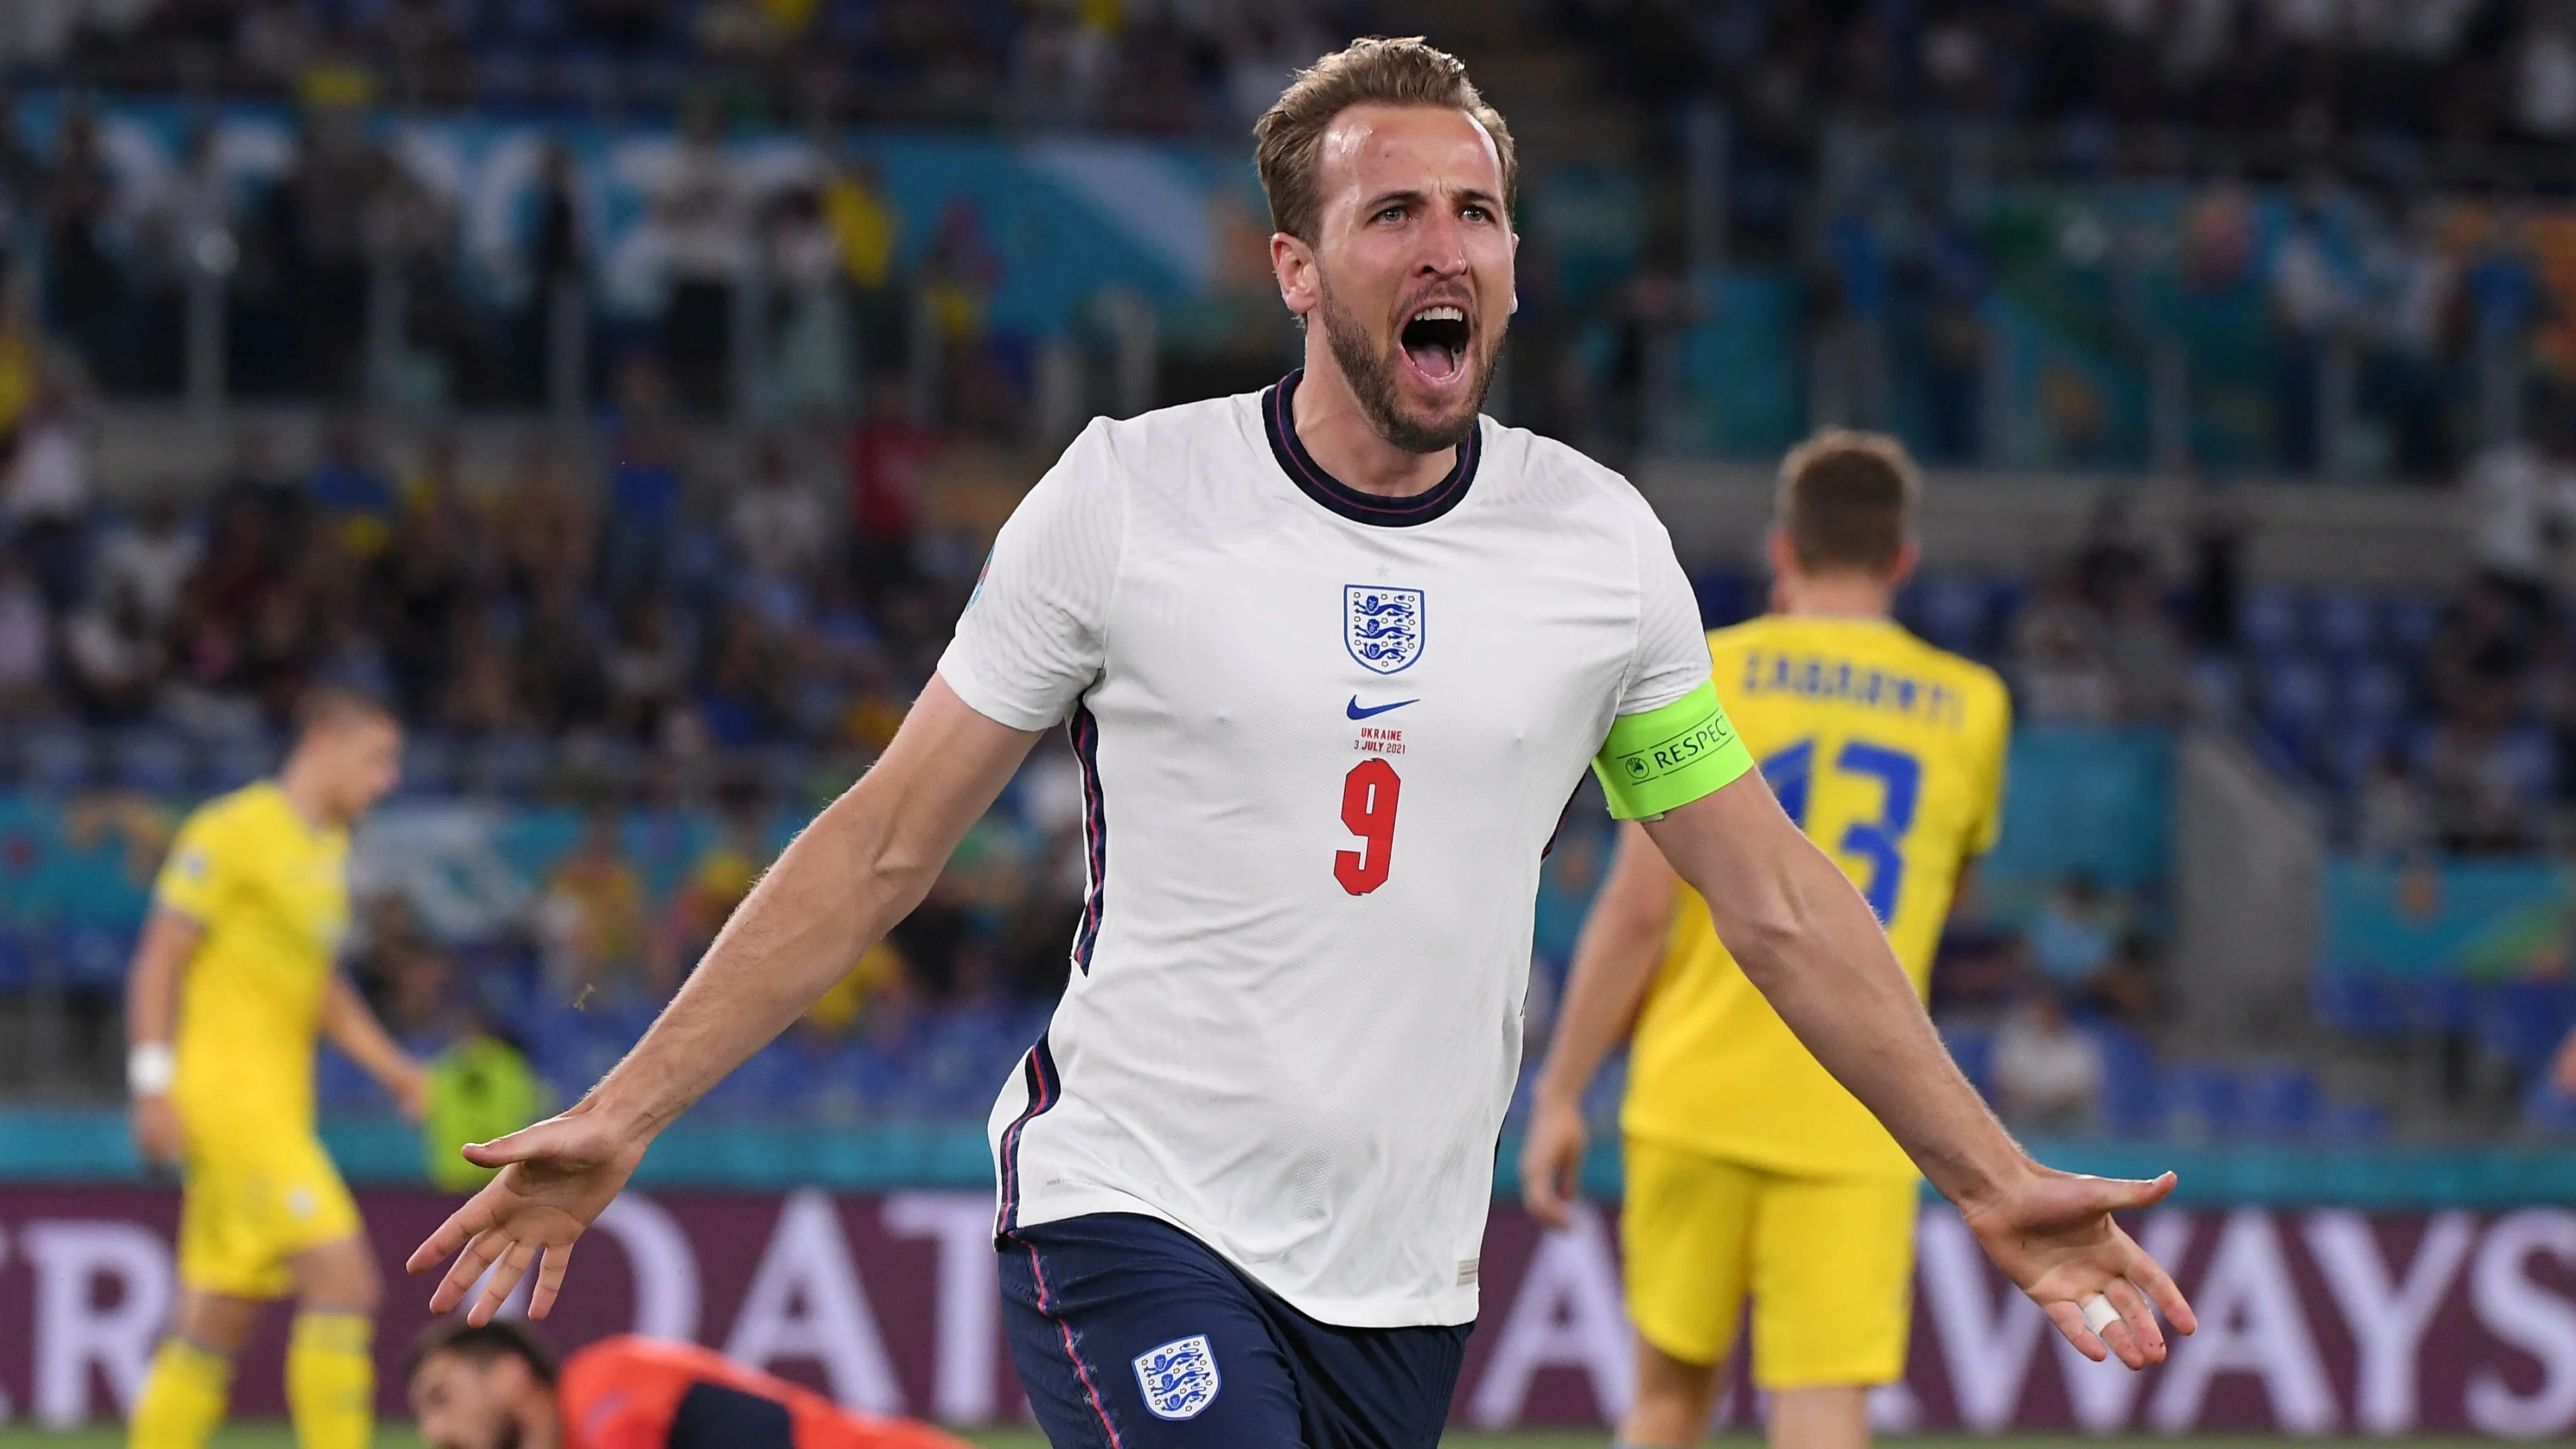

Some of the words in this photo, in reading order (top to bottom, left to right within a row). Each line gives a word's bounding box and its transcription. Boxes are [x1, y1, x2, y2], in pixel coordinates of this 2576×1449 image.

[1354, 739, 1360, 750] 3
[1361, 741, 1384, 753] JULY
[1386, 743, 1405, 755] 2021
[1361, 727, 1402, 741] UKRAINE
[1334, 757, 1401, 896] 9
[1758, 735, 1924, 931] 13
